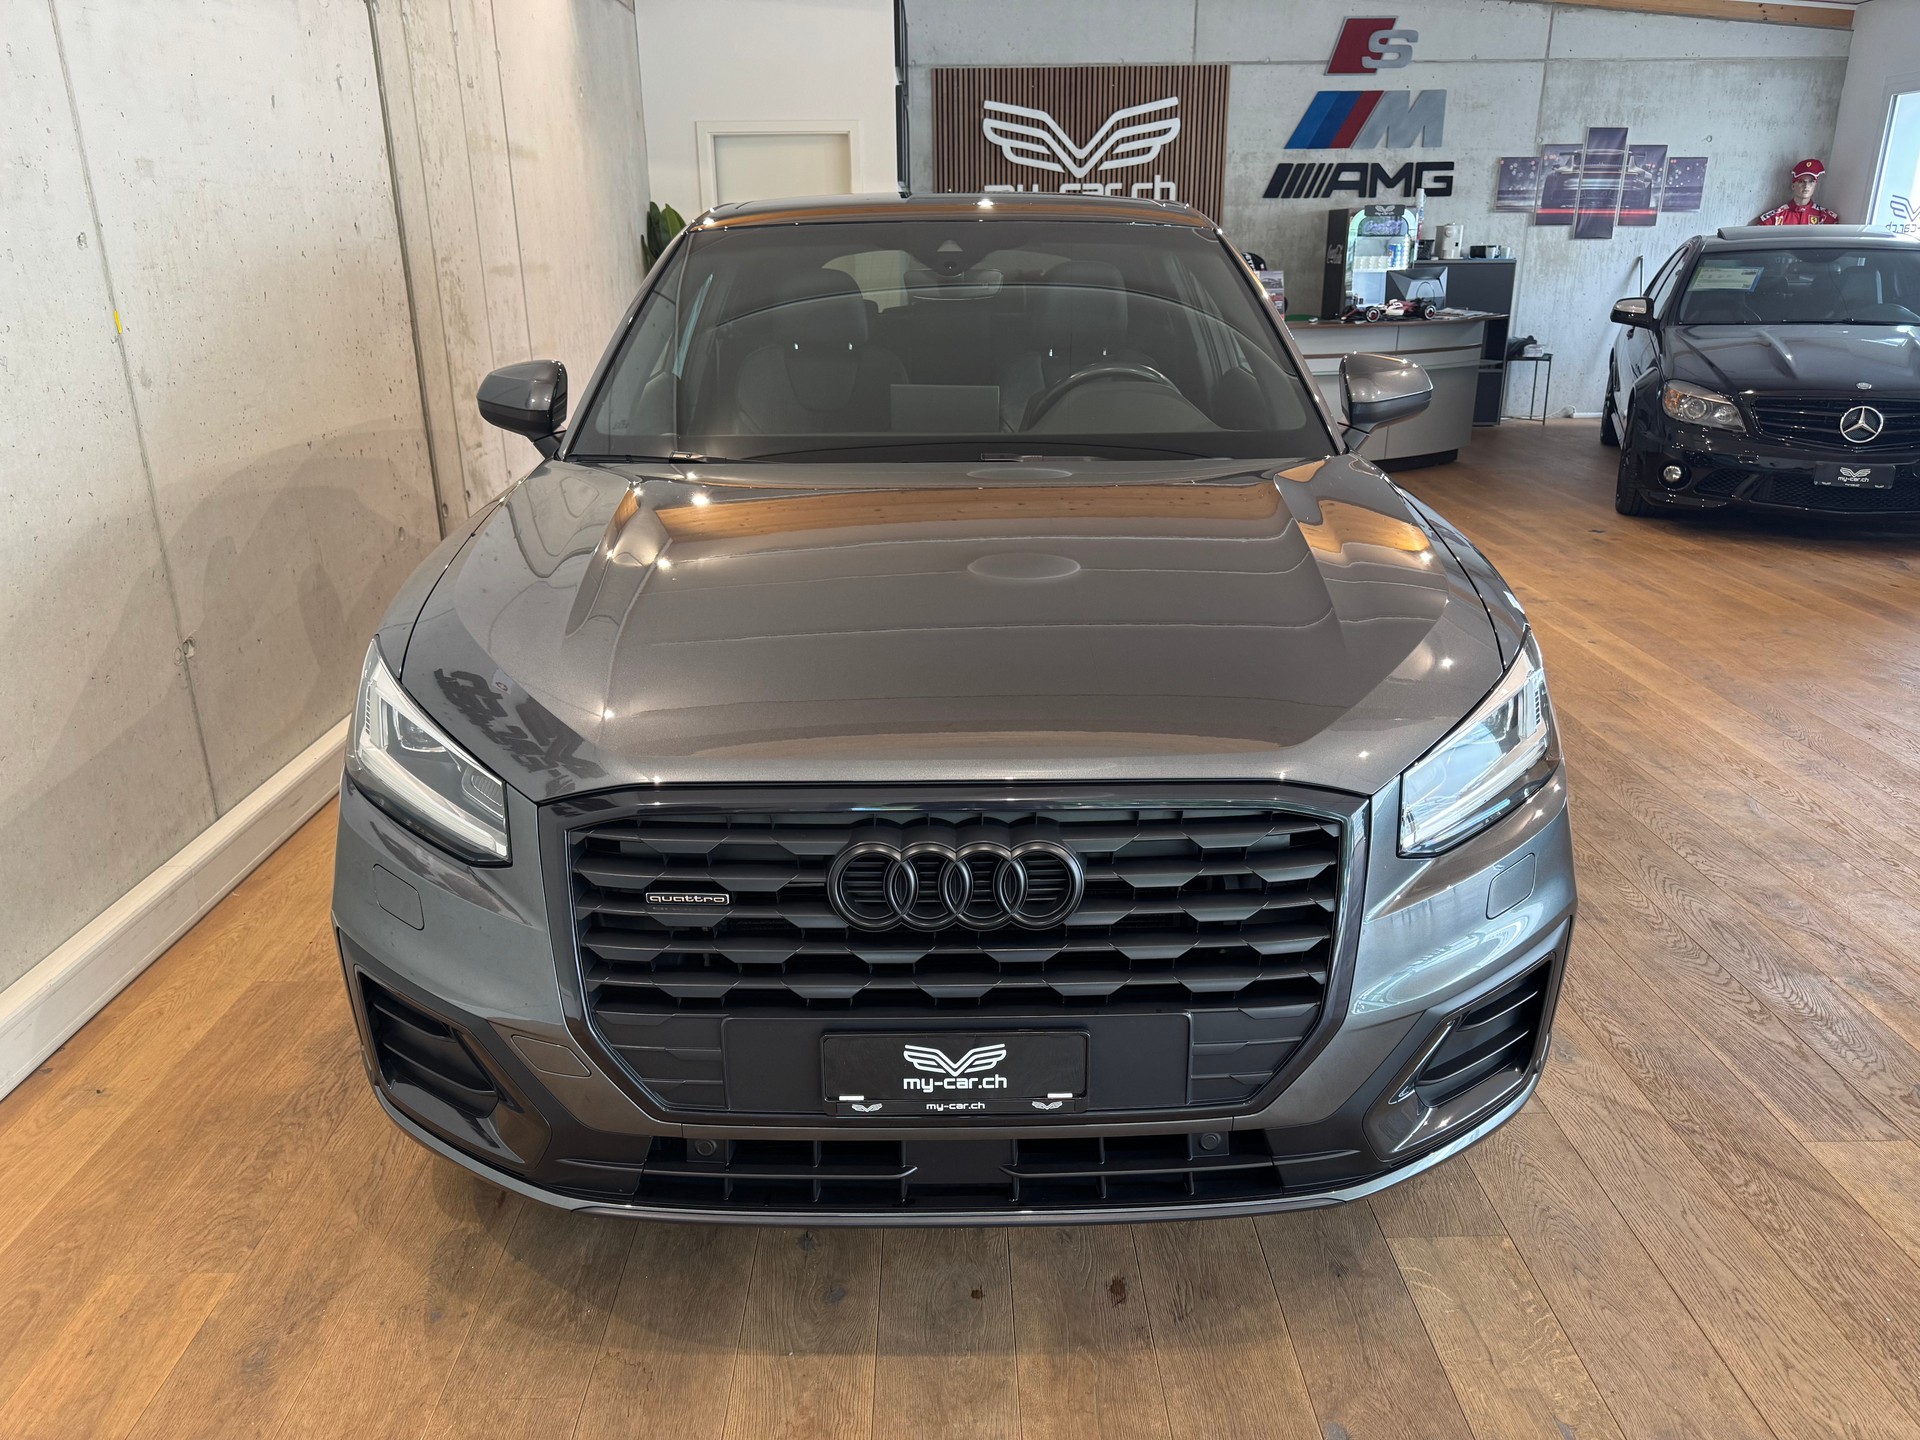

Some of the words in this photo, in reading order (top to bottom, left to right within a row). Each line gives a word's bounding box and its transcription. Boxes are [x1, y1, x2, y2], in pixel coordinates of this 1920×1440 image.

[1351, 89, 1447, 149] M
[1321, 161, 1455, 198] AMG
[649, 895, 725, 903] quattro
[903, 1074, 1008, 1093] my-car.ch
[926, 1101, 986, 1111] my-car.ch
